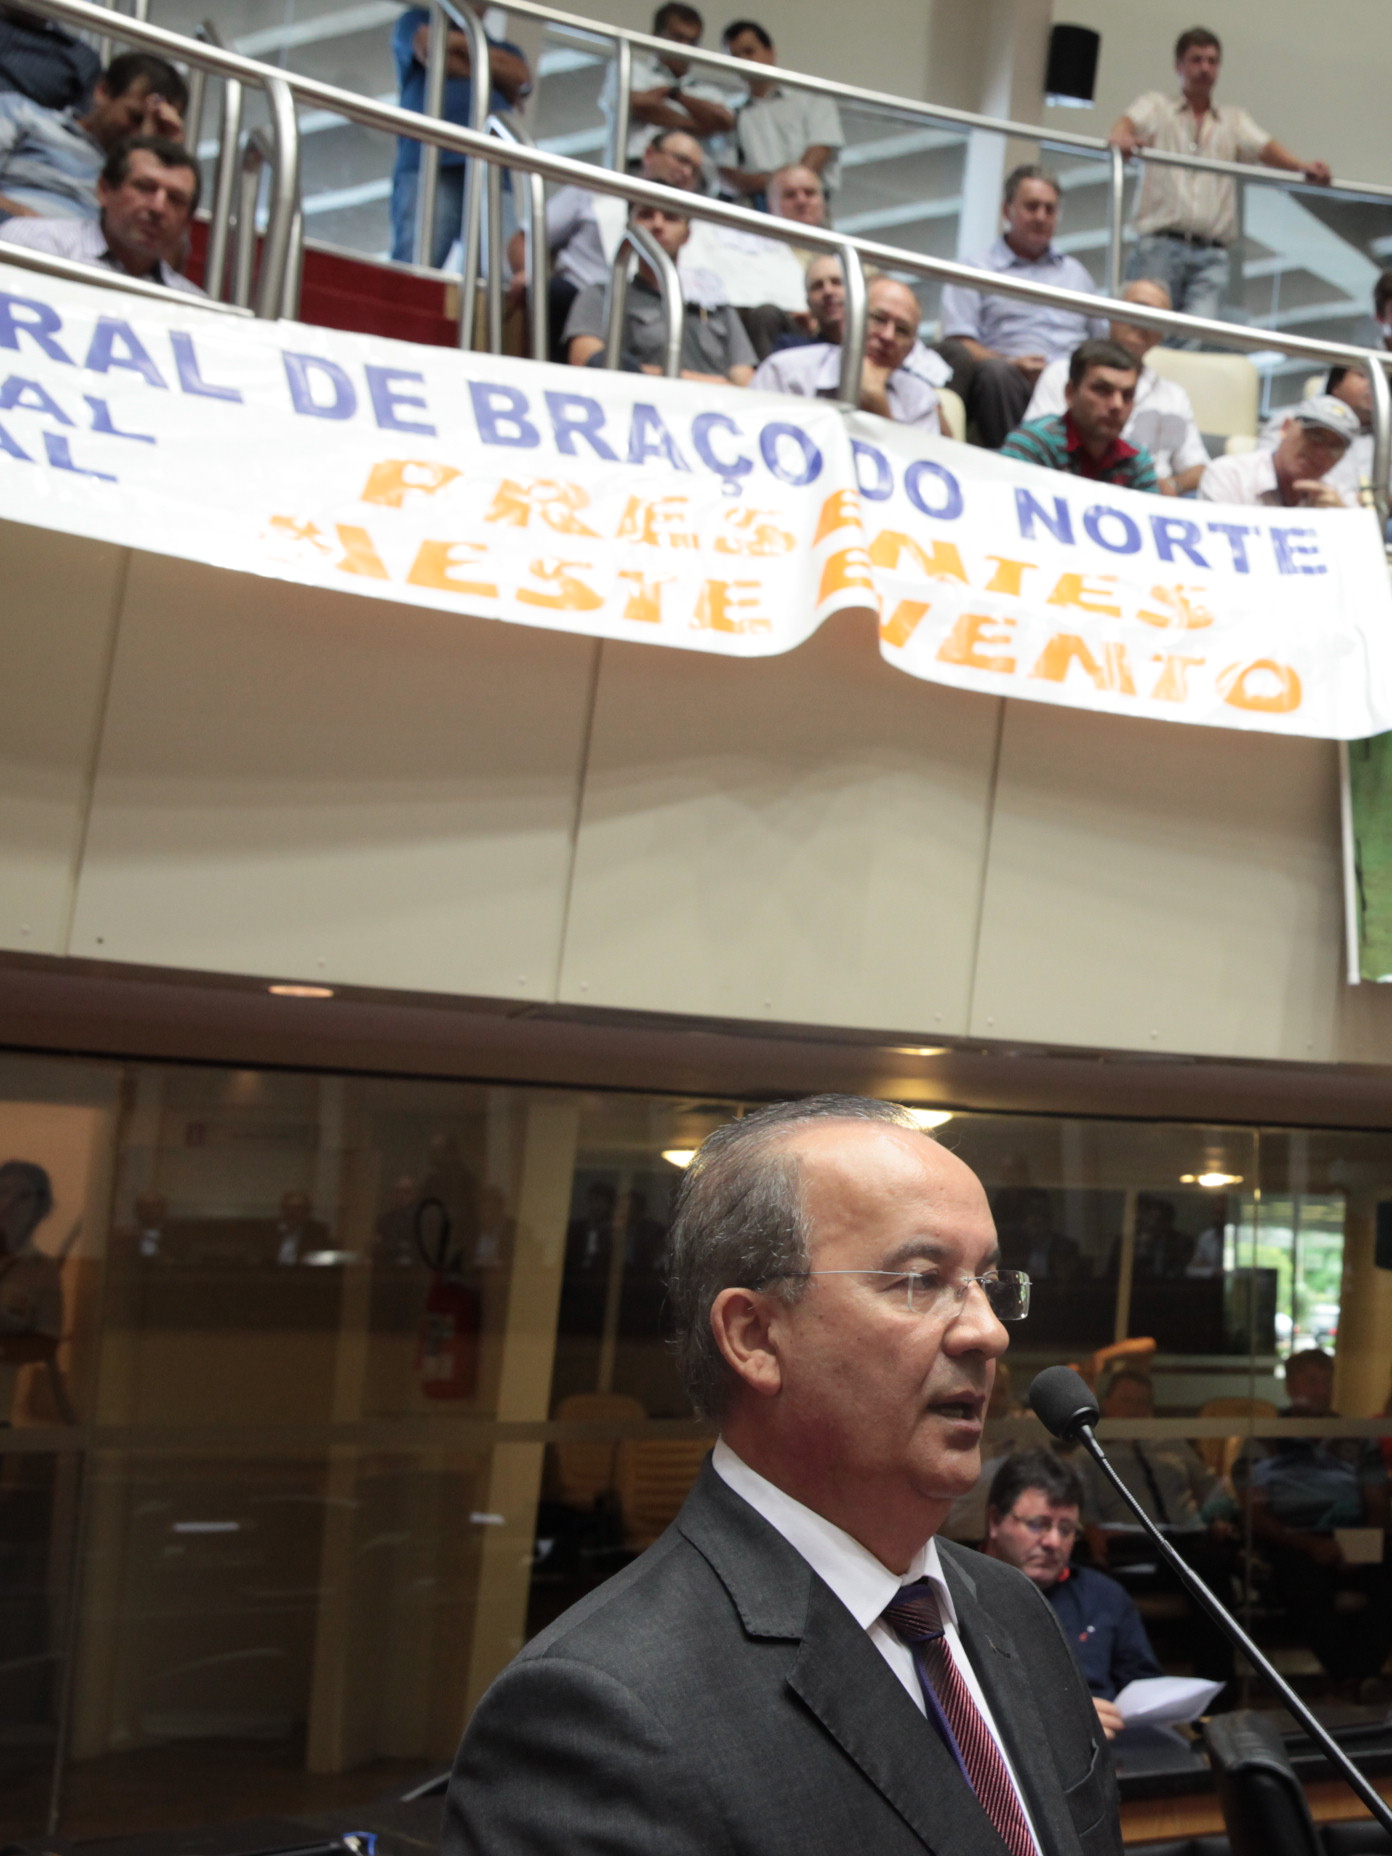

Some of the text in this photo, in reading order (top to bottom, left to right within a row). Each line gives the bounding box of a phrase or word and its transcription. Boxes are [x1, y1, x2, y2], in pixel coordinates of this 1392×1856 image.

[281, 349, 436, 437] DE
[468, 380, 824, 497] BRAÇO
[849, 437, 964, 521] DO
[1014, 486, 1328, 576] NORTE
